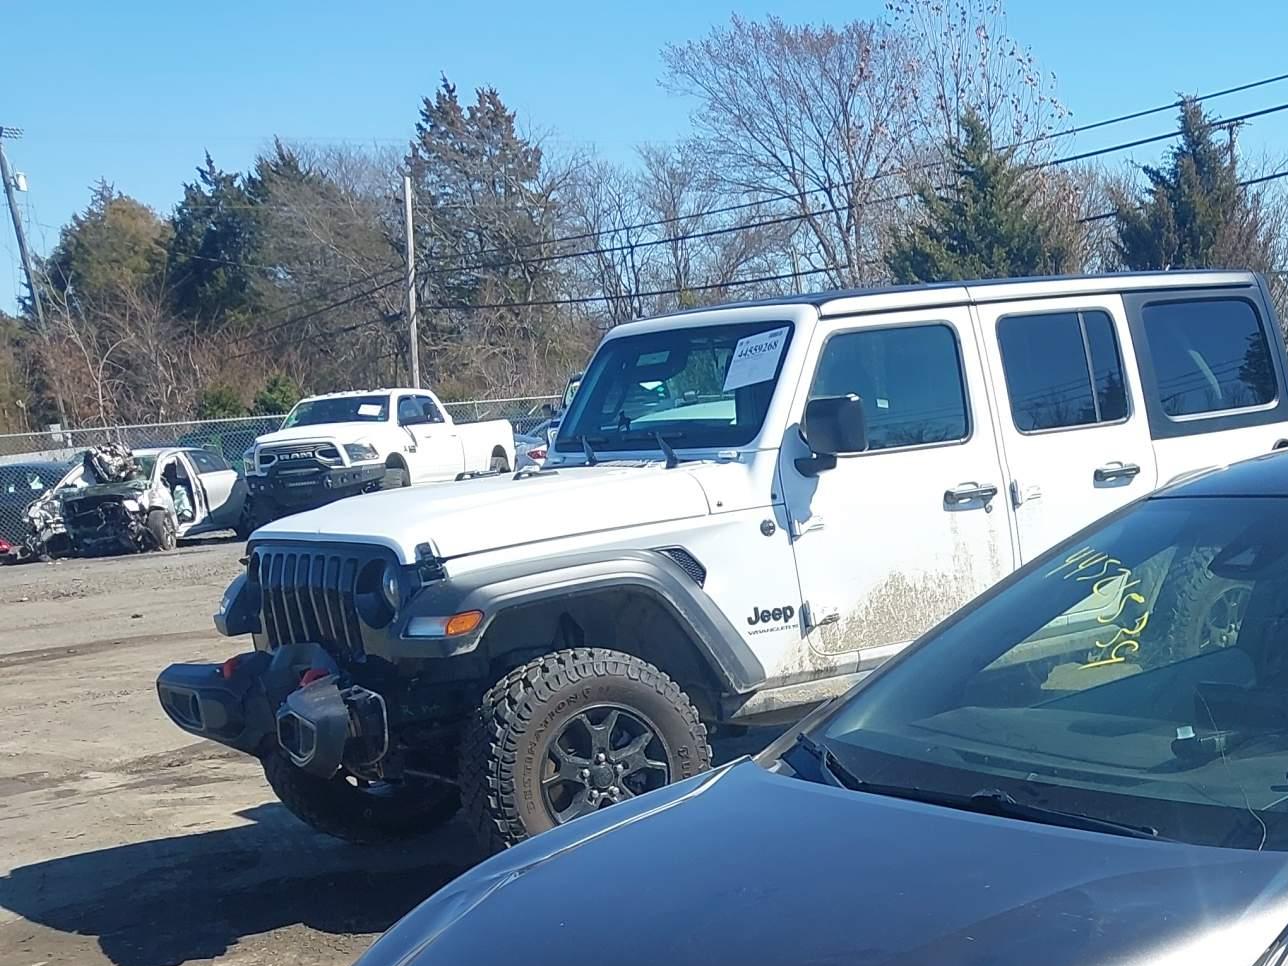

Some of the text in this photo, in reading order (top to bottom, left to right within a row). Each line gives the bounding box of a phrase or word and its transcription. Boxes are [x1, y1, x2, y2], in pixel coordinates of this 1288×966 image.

[738, 340, 779, 358] 44559268
[279, 451, 313, 460] RAM
[747, 605, 795, 626] Jeep
